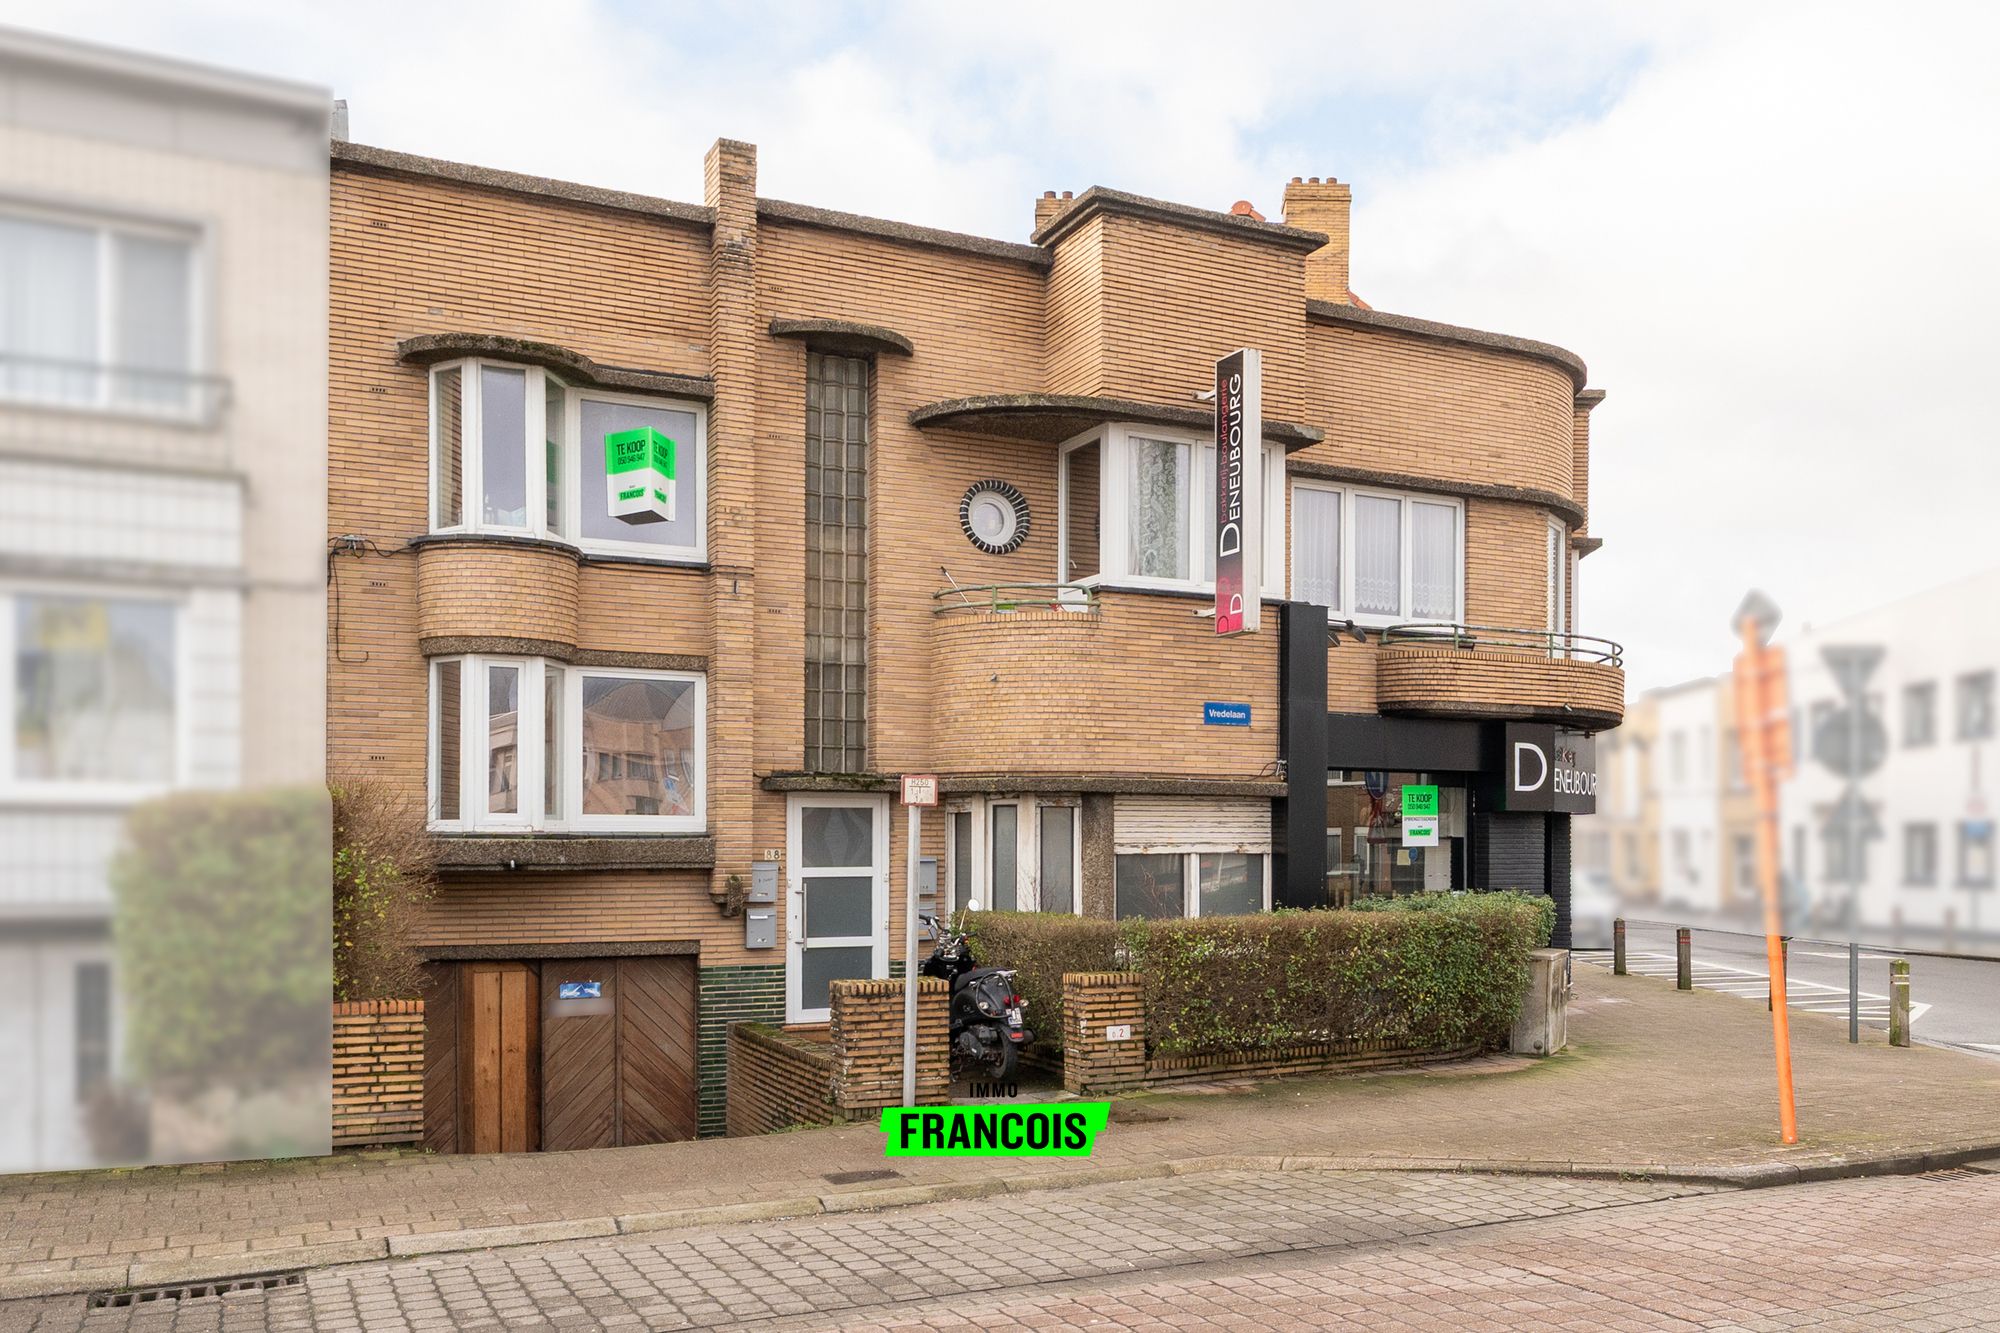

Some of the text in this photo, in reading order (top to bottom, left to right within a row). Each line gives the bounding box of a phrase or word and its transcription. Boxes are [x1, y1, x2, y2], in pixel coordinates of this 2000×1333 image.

[616, 439, 646, 456] TE KOOP
[1220, 379, 1228, 523] bakkerij-boulangerie
[1220, 373, 1241, 557] DENEUBOURG
[1208, 709, 1246, 719] Vredelaan
[1407, 793, 1433, 803] TE KOOP
